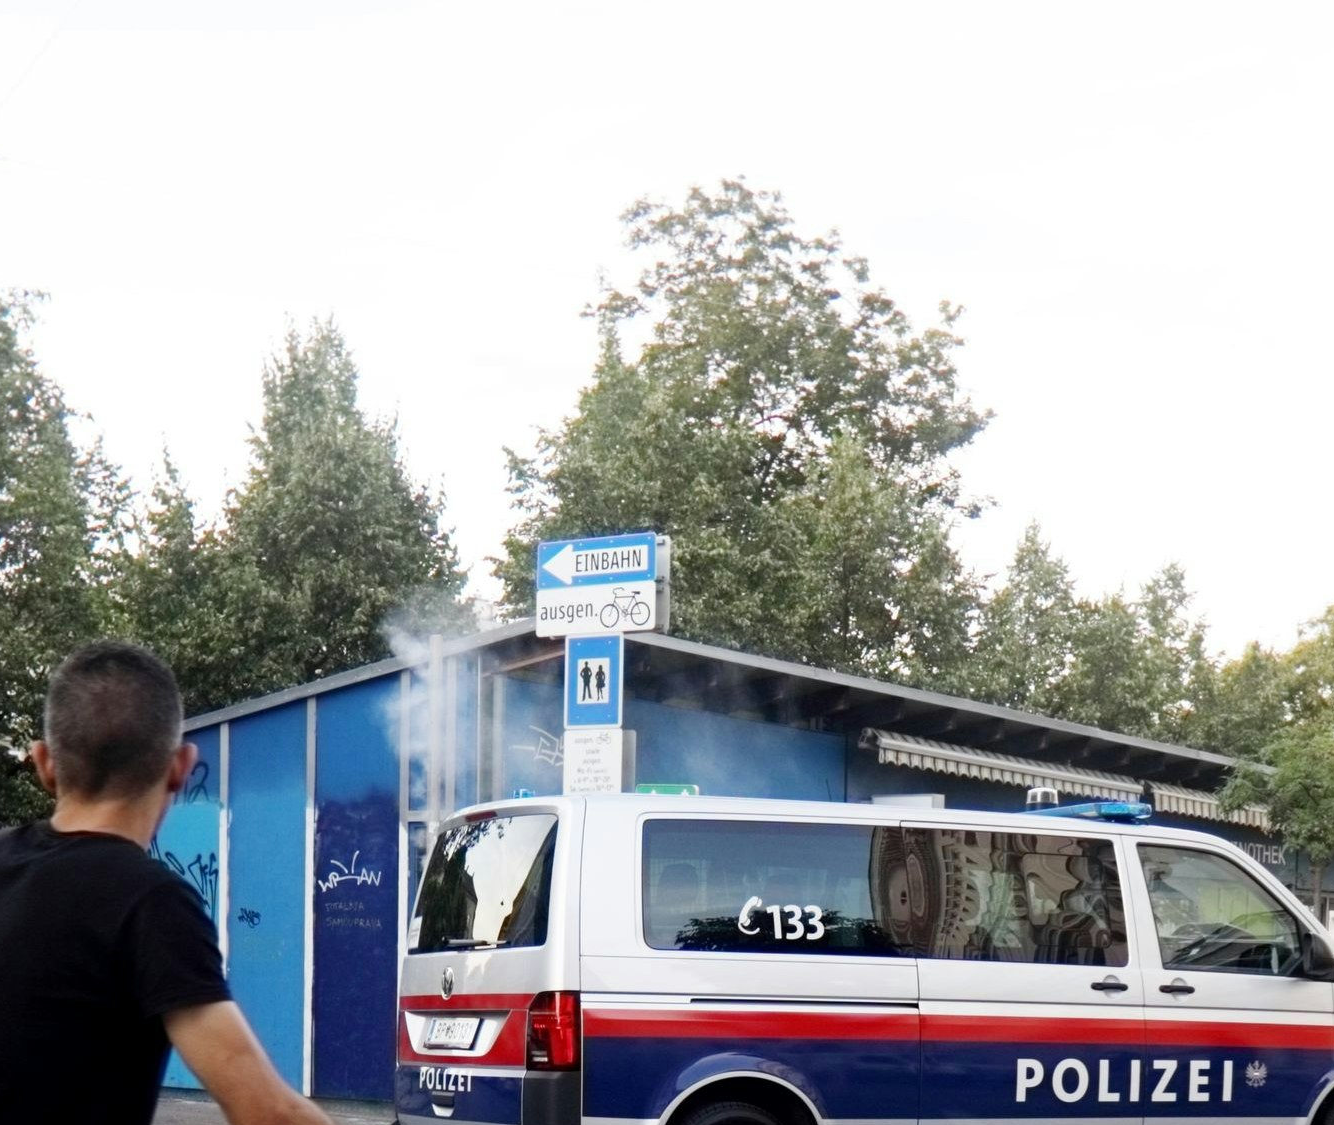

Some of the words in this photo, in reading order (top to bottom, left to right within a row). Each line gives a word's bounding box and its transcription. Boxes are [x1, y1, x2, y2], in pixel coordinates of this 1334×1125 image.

[575, 549, 642, 572] EINBAHN
[540, 602, 598, 623] ausgen.
[766, 904, 825, 940] 133
[419, 1067, 471, 1092] POLIZEI
[1015, 1058, 1234, 1103] POLIZEI
